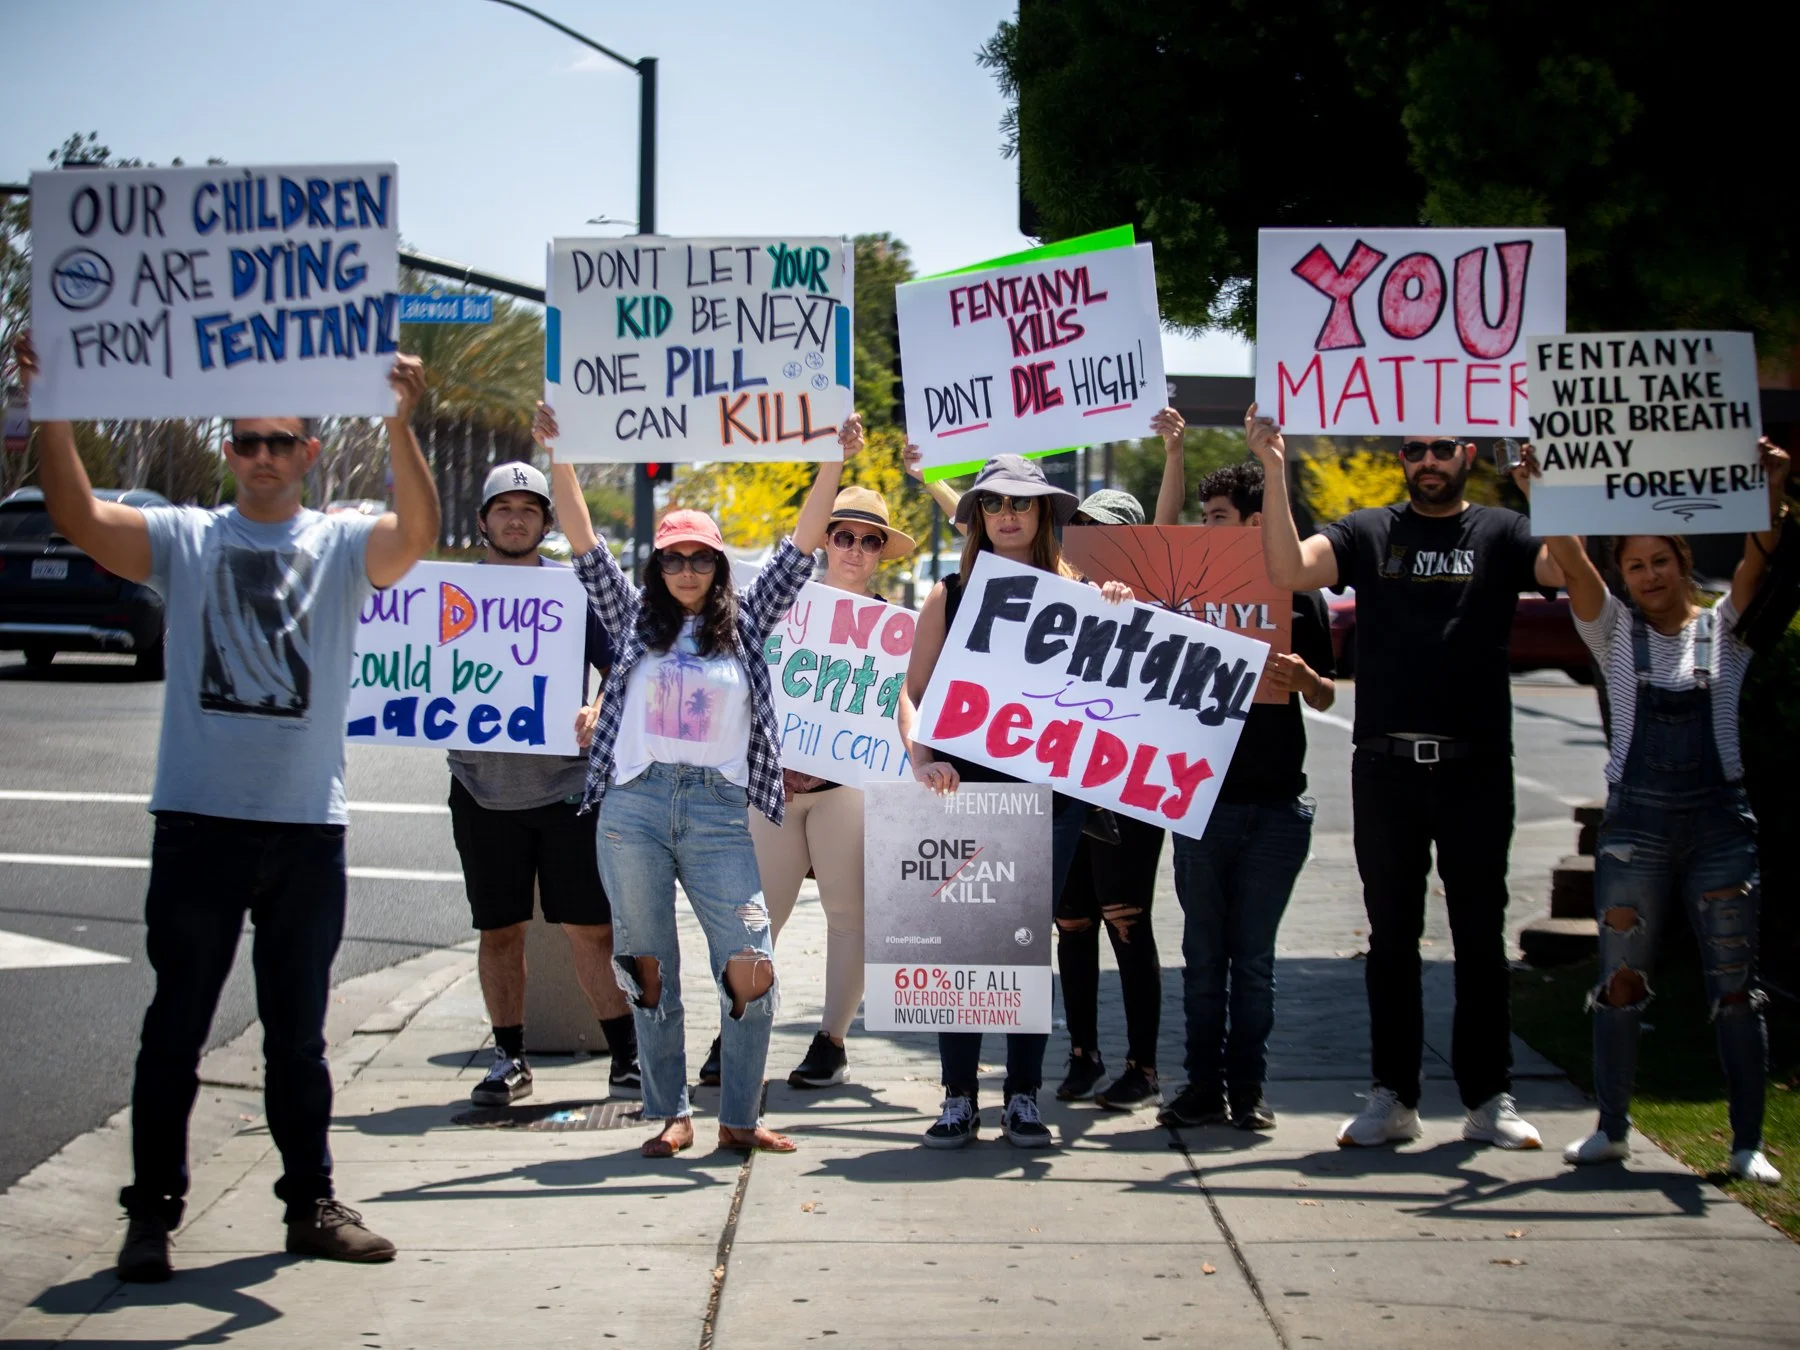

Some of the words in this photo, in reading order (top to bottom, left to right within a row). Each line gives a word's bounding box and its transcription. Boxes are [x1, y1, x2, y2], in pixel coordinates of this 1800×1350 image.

[70, 182, 166, 237] OUR
[132, 249, 214, 306] ARE
[687, 243, 761, 287] LET
[767, 242, 831, 294] YOUR
[949, 265, 1108, 329] FENTANYL
[1291, 238, 1533, 360] YOU
[70, 309, 173, 379] FROM
[194, 292, 399, 373] FENTANYL
[615, 295, 674, 340] KID
[691, 295, 732, 335] BE
[736, 292, 841, 353] NEXT
[1007, 308, 1085, 358] KILLS
[574, 353, 647, 396] ONE
[665, 345, 769, 398] PILL
[1010, 360, 1065, 419] DIE
[1069, 339, 1148, 406] HIGH!
[1553, 376, 1630, 407] WILL
[1640, 372, 1724, 403] TAKE
[615, 404, 687, 440] CAN
[719, 391, 838, 446] KILL
[1528, 407, 1616, 440] YOUR
[1629, 402, 1752, 432] BREATH
[512, 467, 528, 486] LA
[1543, 439, 1634, 471] AWAY
[1606, 463, 1766, 500] FOREVER!!
[1412, 548, 1475, 576] STACKS
[360, 587, 426, 625] our
[437, 581, 564, 666] Drugs
[829, 599, 916, 657] NO
[452, 648, 503, 694] be
[1021, 680, 1140, 721] is
[780, 713, 822, 756] Pill
[943, 792, 1045, 816] #FENTANYL
[901, 860, 953, 881] PILL
[957, 861, 1015, 882] CAN
[918, 839, 976, 860] ONE
[940, 882, 996, 904] KILL
[894, 967, 951, 990] 60%
[954, 970, 977, 990] OF
[987, 970, 1021, 991] ALL
[894, 991, 964, 1007] OVERDOSE
[969, 991, 1021, 1008] DEATHS
[895, 1008, 954, 1025] INVOLVED
[957, 1009, 1021, 1026] FENTANYL
